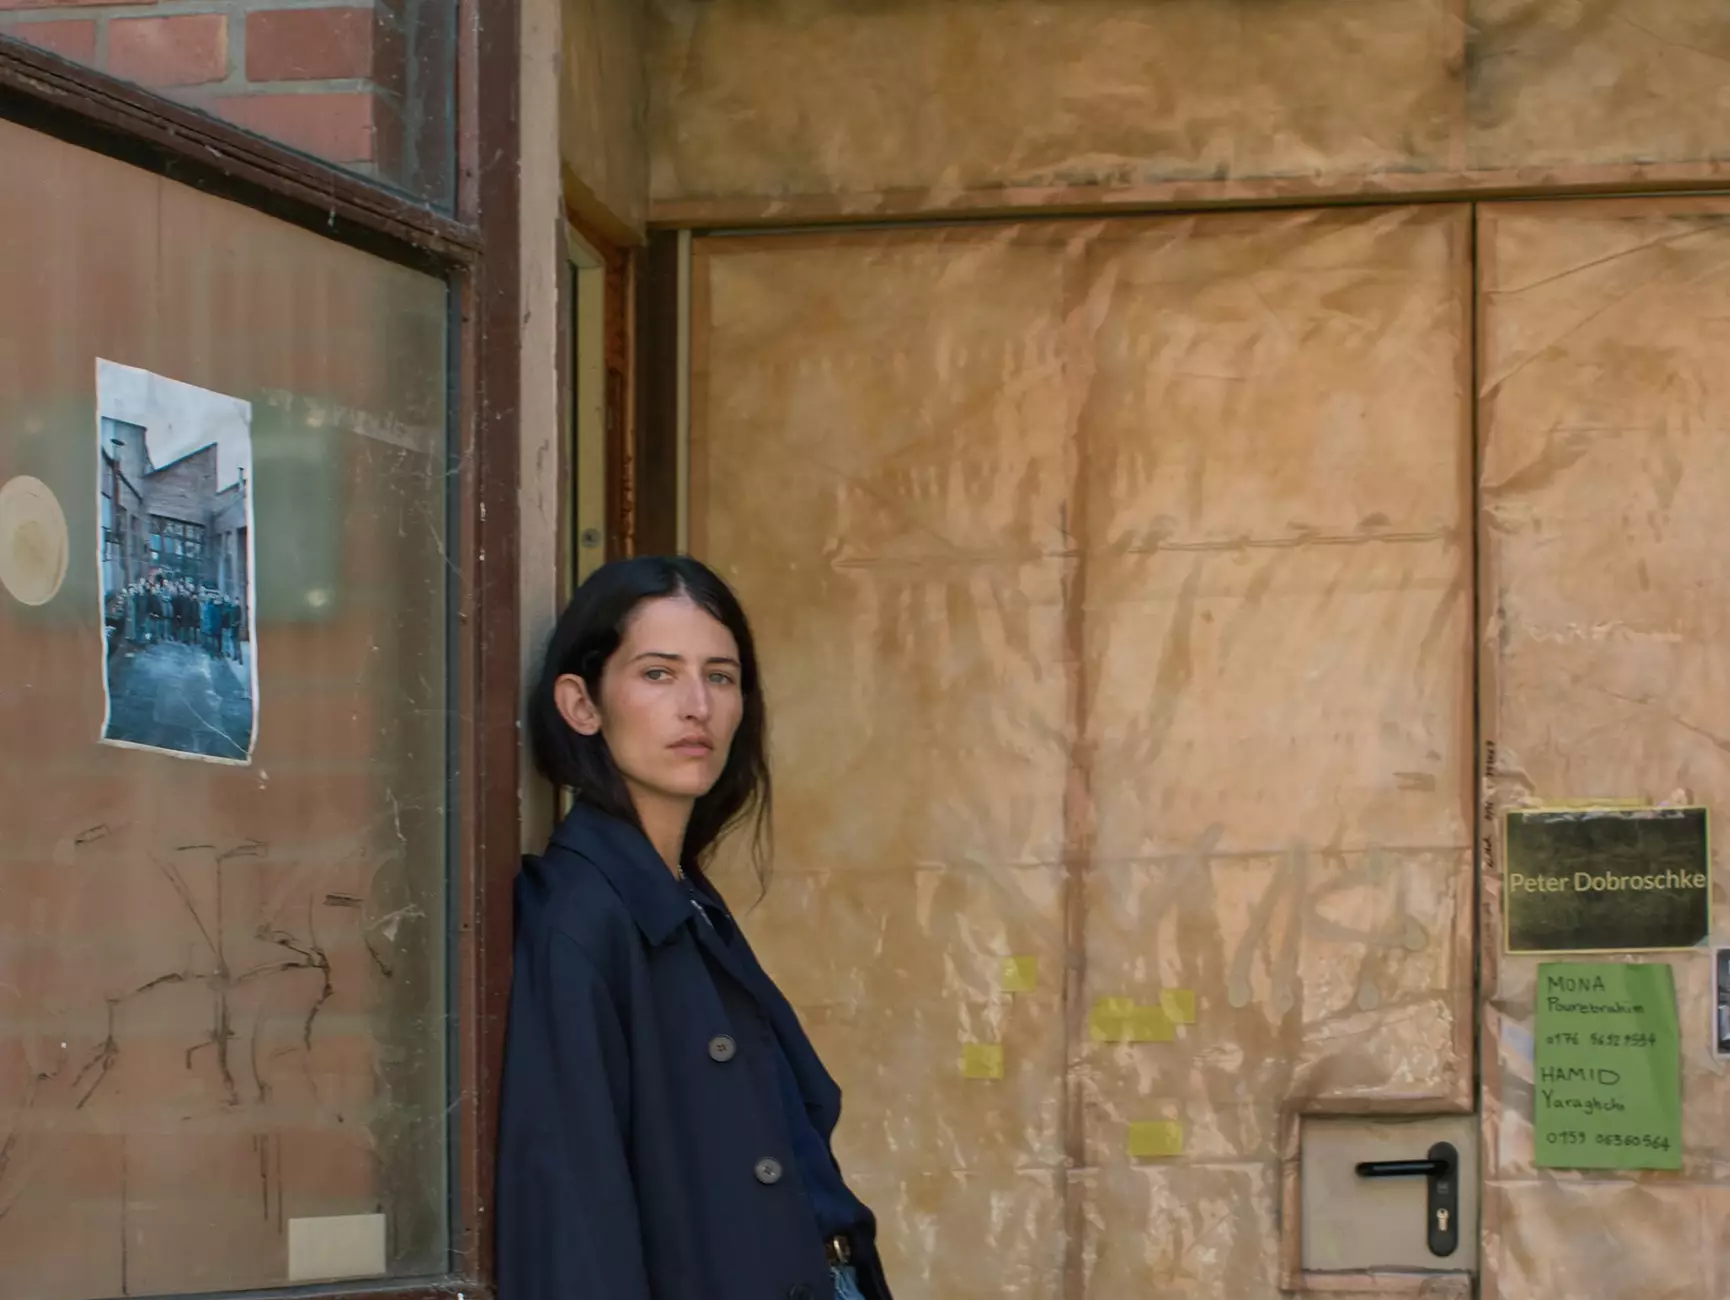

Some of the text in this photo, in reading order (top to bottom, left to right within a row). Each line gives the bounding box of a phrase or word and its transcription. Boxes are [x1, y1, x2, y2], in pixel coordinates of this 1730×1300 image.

[1510, 869, 1706, 893] Peter Dobroschke
[1547, 975, 1605, 992] MONA
[1541, 1066, 1620, 1085] HAMID
